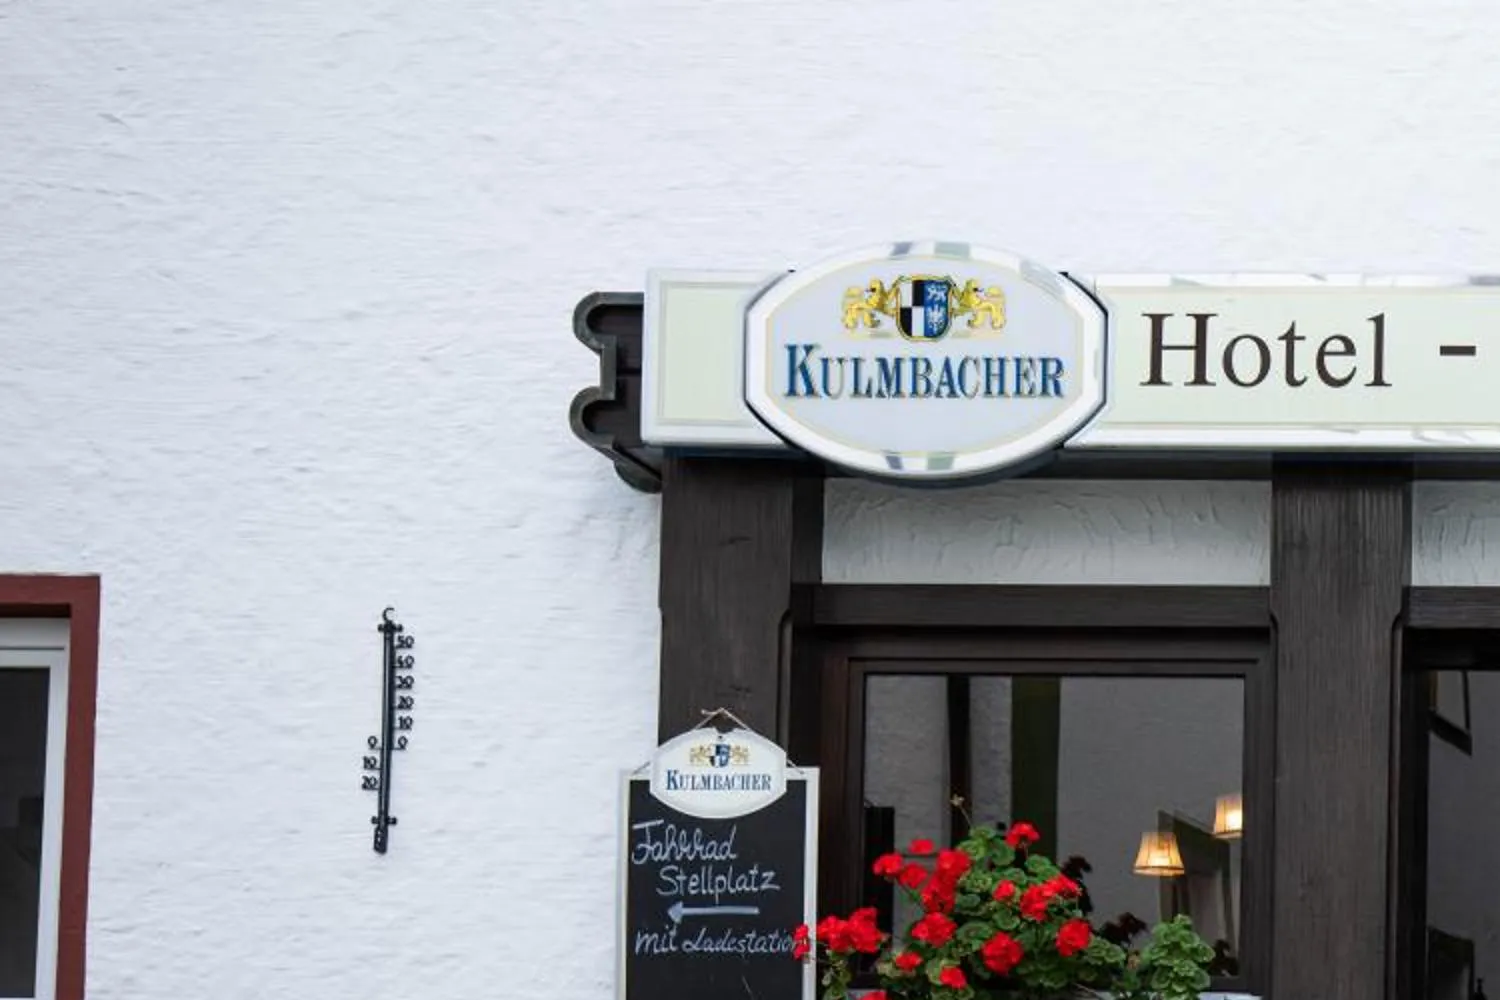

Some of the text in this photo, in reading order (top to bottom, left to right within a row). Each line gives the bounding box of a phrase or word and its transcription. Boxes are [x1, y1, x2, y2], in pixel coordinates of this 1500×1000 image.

[1140, 312, 1392, 388] Hotel
[1439, 345, 1476, 356] -
[783, 343, 1065, 399] KULMBACHER
[397, 635, 415, 649] 50
[396, 675, 415, 689] 30
[398, 695, 414, 709] 20
[398, 715, 413, 730] 10
[367, 735, 378, 749] 0
[398, 735, 409, 749] 0
[363, 755, 378, 770] 10
[362, 775, 379, 790] 20
[666, 769, 772, 790] KULMBACHER
[632, 819, 739, 865] Fahrrad
[656, 864, 781, 905] Stellplatz
[681, 926, 797, 956] Ladestatio
